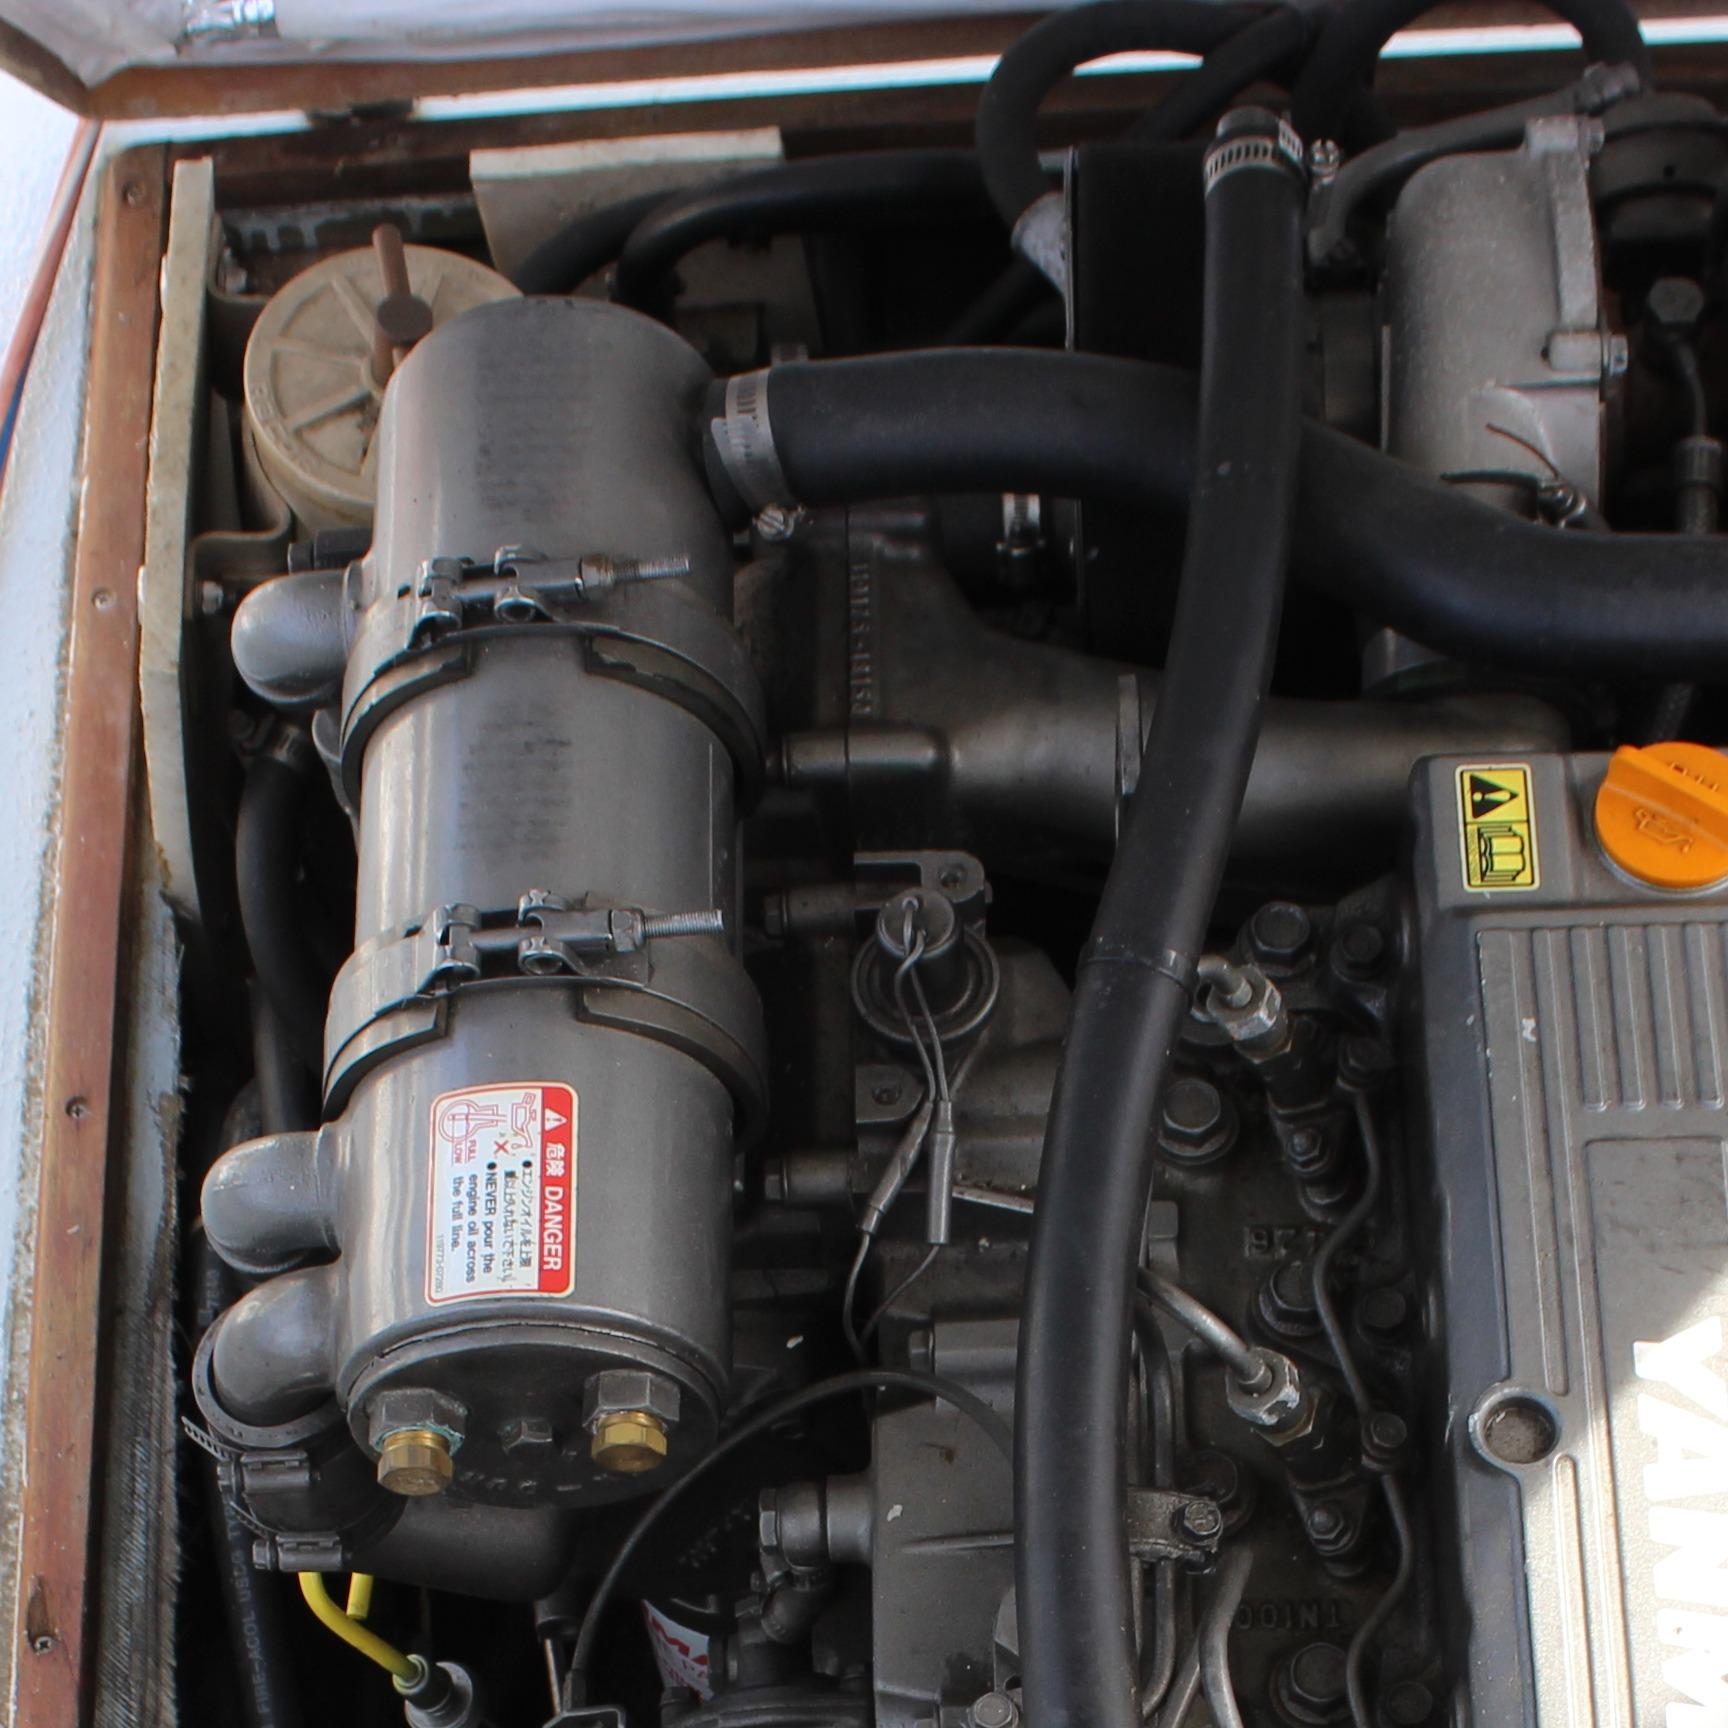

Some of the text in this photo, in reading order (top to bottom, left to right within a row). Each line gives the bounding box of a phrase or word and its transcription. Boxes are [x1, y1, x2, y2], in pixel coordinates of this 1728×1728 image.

[545, 1143, 565, 1177] 危険
[451, 1176, 464, 1251] the full line.
[466, 1173, 478, 1284] engine oil across
[482, 1172, 497, 1274] NEVER pour the
[543, 1187, 563, 1271] DANGER
[242, 1617, 271, 1713] FIRE-ACOL
